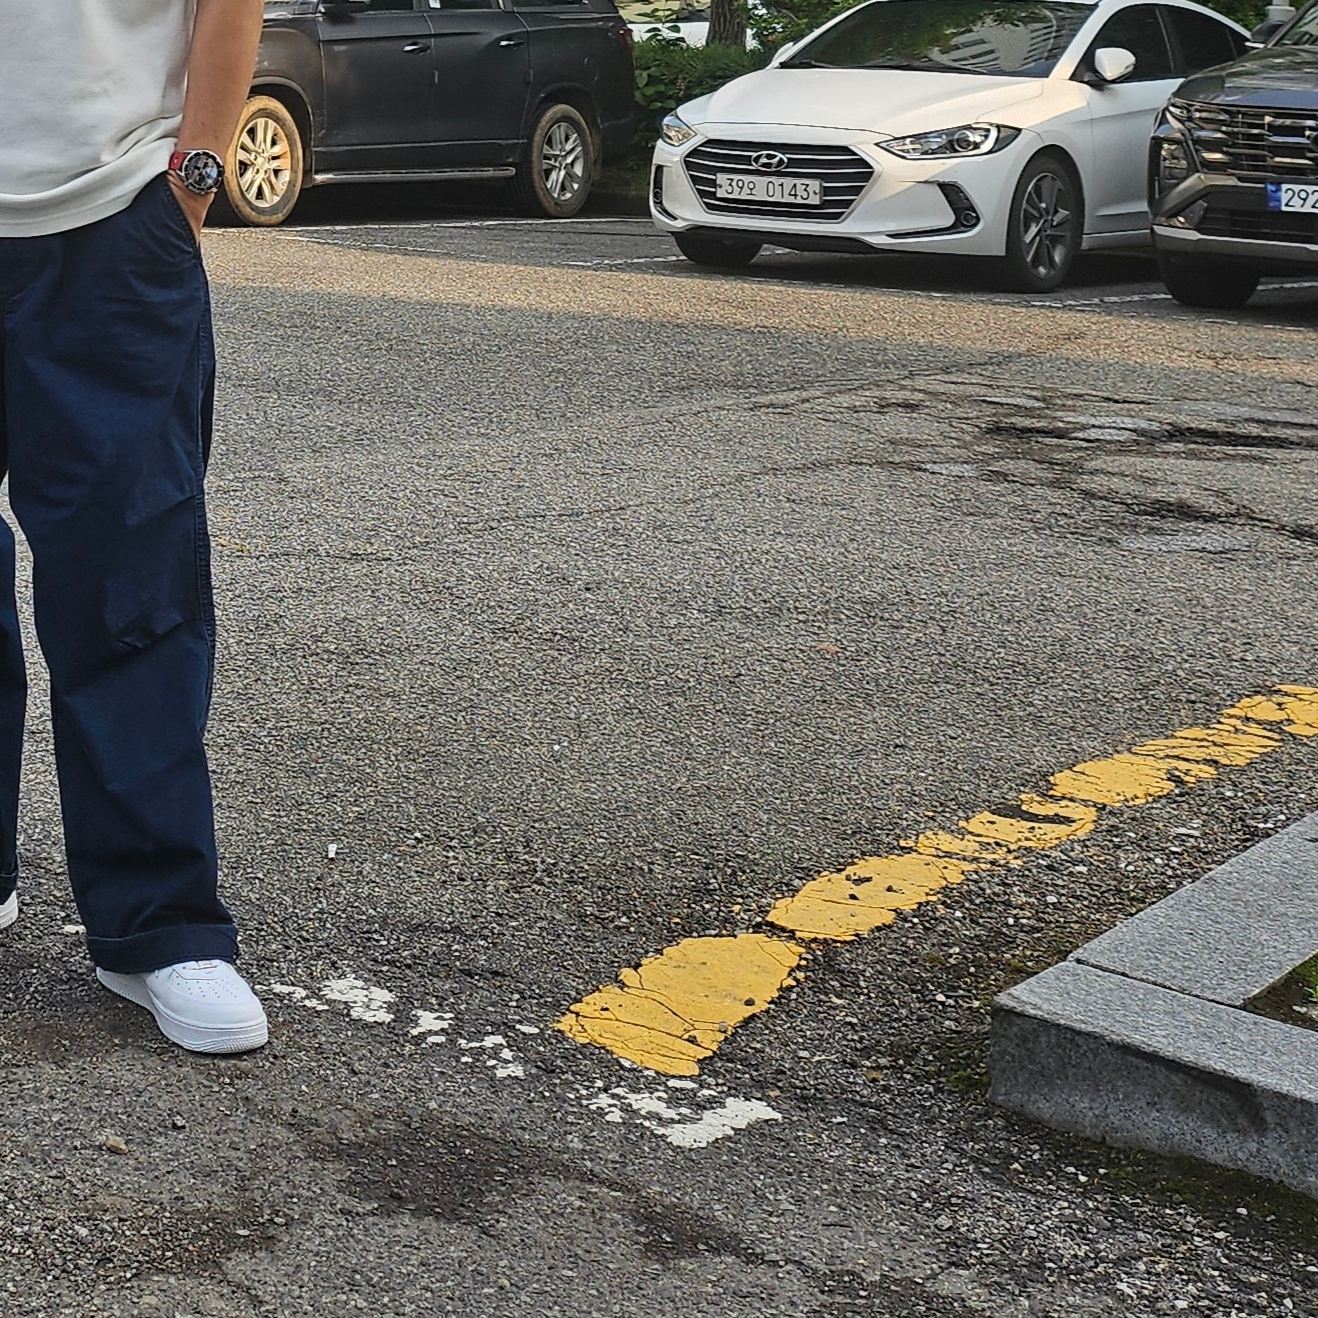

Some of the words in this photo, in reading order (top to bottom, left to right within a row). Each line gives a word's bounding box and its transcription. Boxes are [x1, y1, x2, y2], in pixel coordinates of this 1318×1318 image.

[725, 178, 757, 197] 39오
[766, 180, 810, 201] 0143
[1284, 187, 1318, 209] 292
